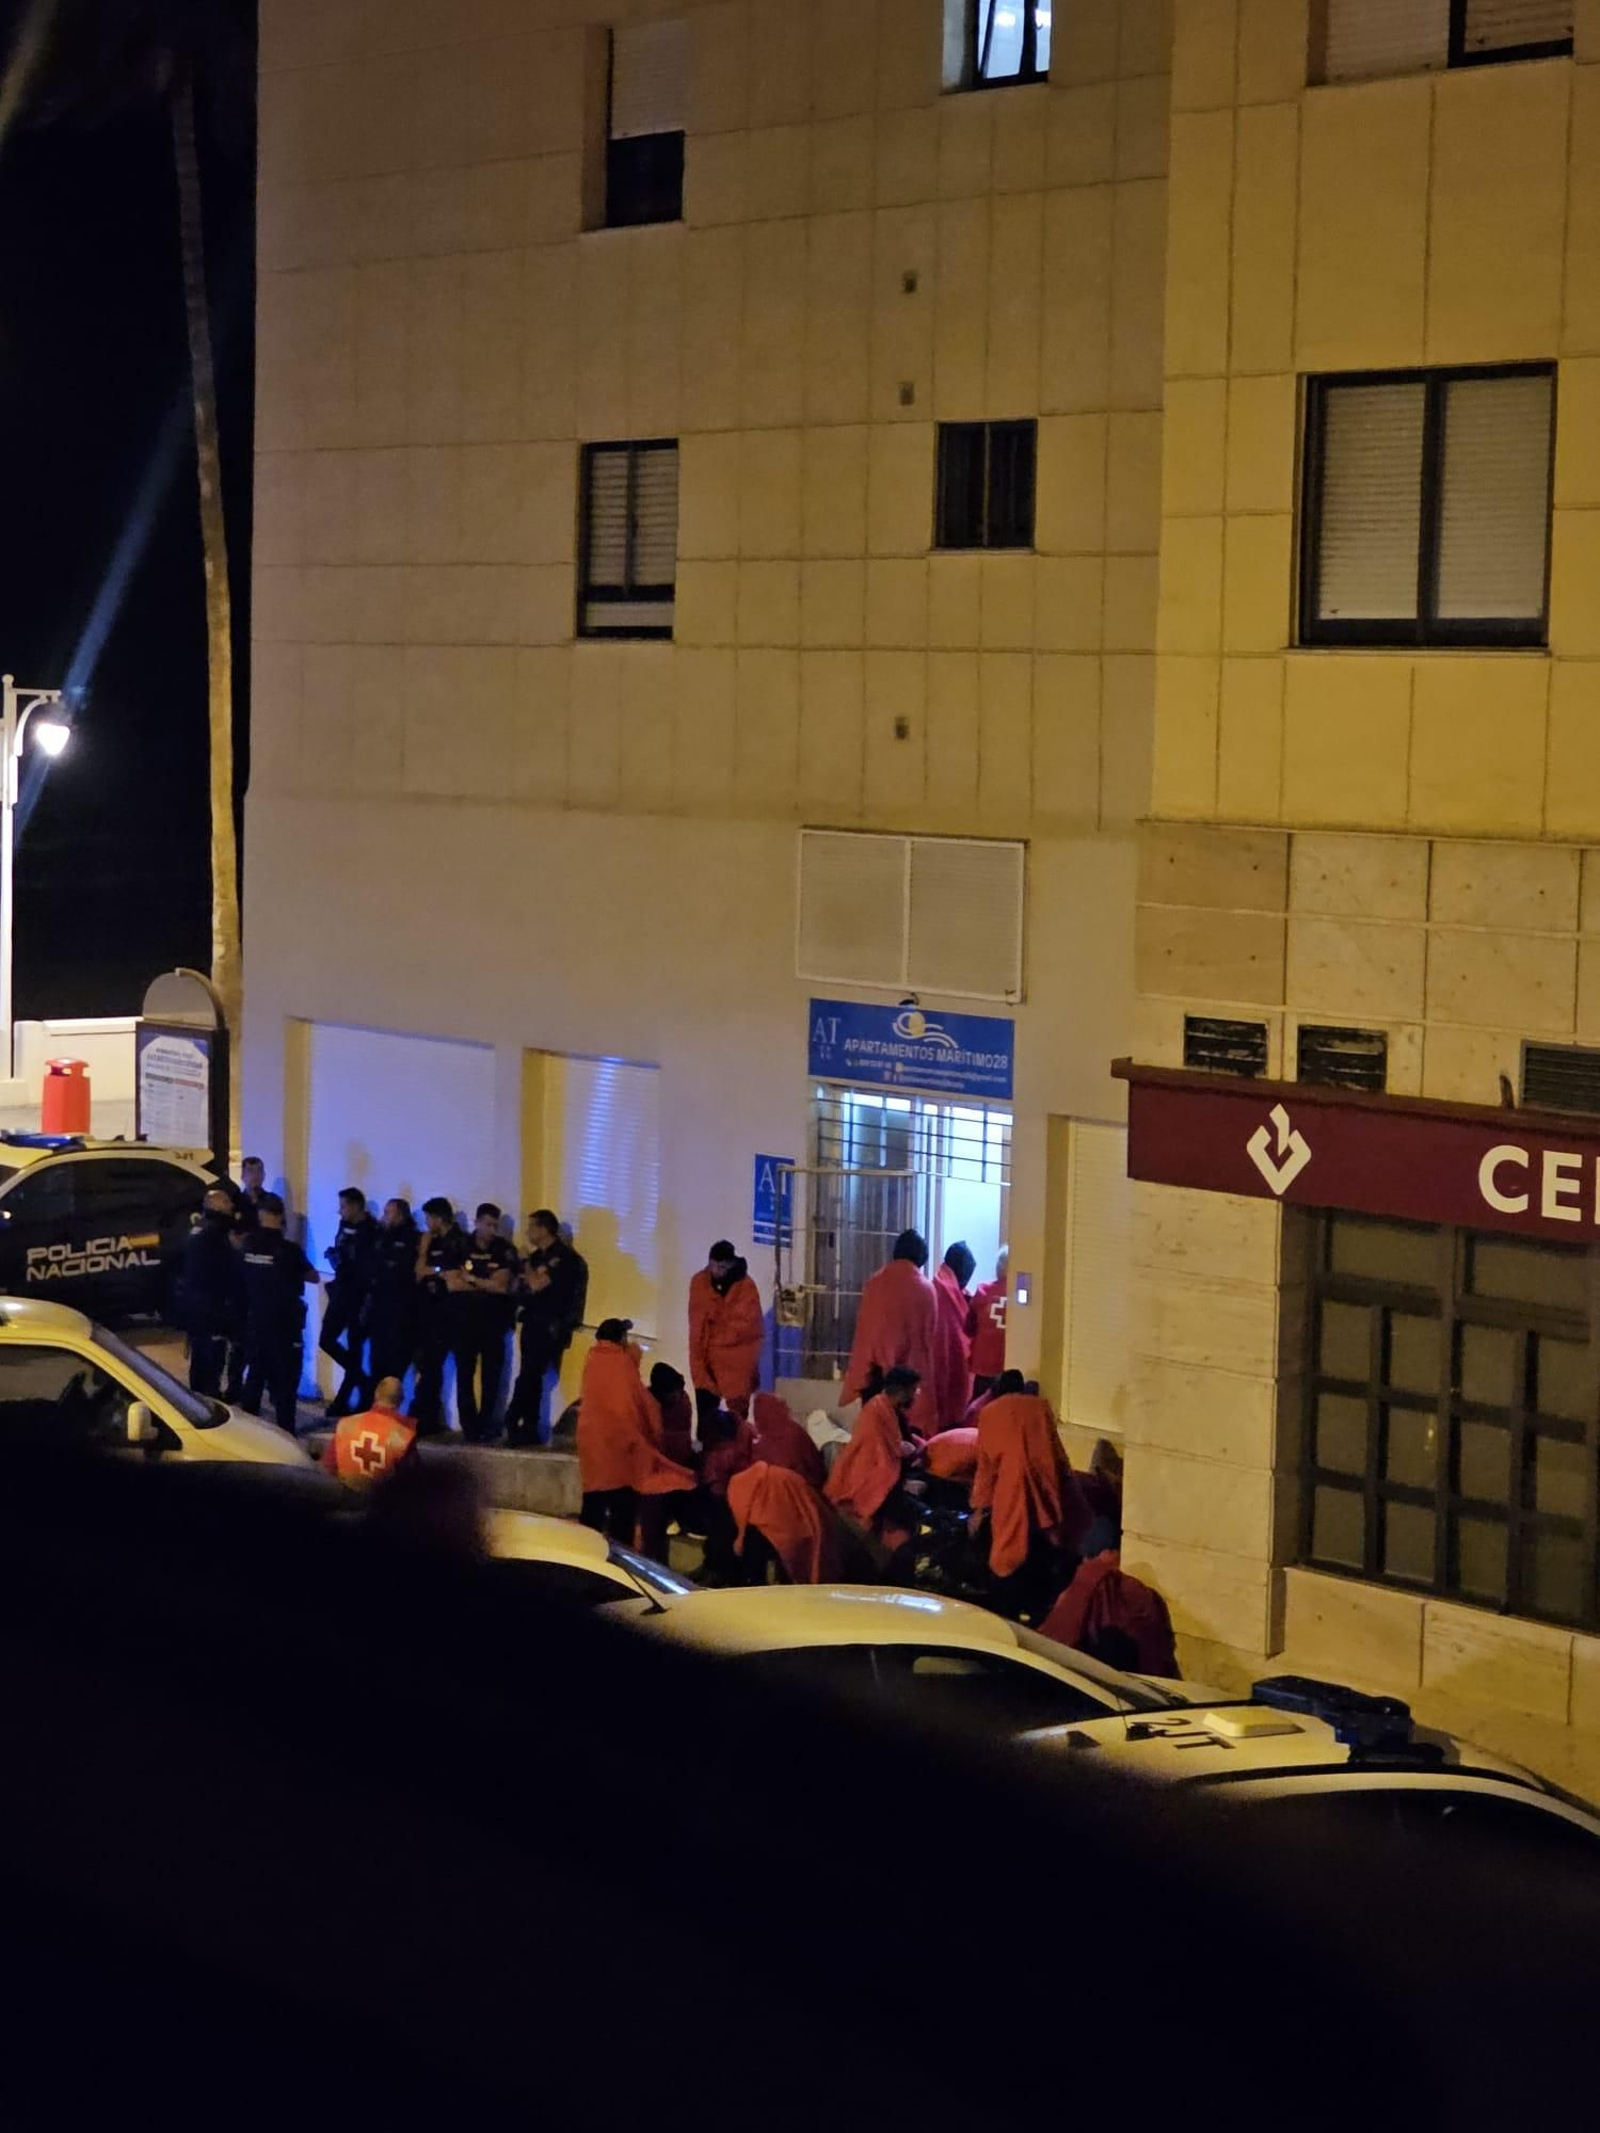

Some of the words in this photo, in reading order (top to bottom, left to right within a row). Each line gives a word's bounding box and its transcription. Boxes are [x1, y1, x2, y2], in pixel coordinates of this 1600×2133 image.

[812, 1017, 841, 1044] AT
[844, 1037, 934, 1061] APARTAMENTOS
[1479, 1145, 1600, 1225] CE
[26, 1236, 133, 1265] POLICIA
[26, 1250, 161, 1282] NACIONAL
